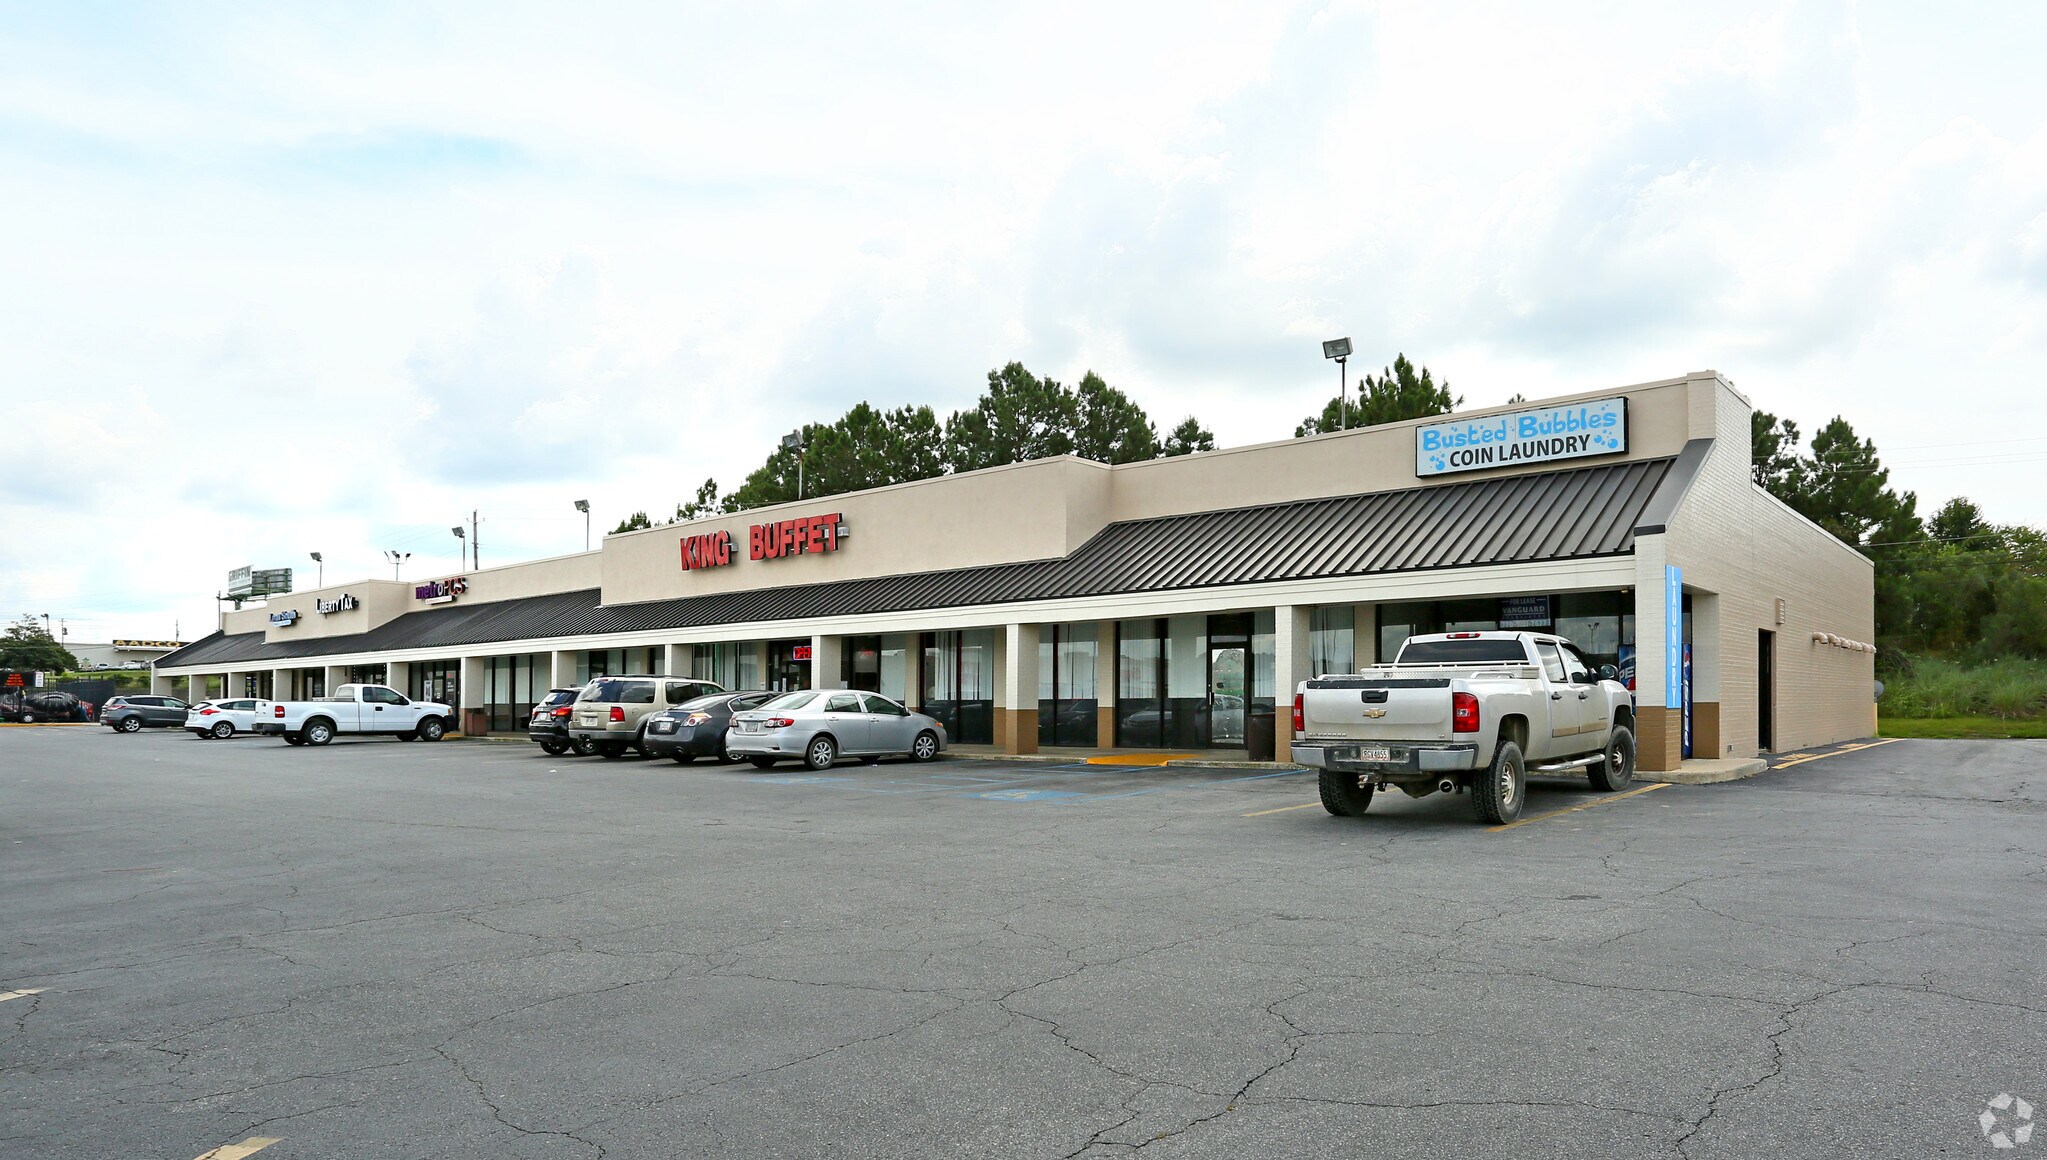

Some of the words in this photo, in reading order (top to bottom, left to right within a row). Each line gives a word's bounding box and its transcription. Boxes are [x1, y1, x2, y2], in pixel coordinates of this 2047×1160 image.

[1422, 419, 1507, 451] Busted
[1518, 408, 1617, 439] Bubbles
[1450, 446, 1493, 467] COIN
[1499, 434, 1591, 462] LAUNDRY
[680, 529, 730, 571] KING
[749, 512, 842, 561] BUFFET
[415, 576, 465, 600] metroPCS
[340, 593, 354, 611] TAX
[1502, 605, 1545, 614] VANGUARD
[794, 646, 812, 659] OPE
